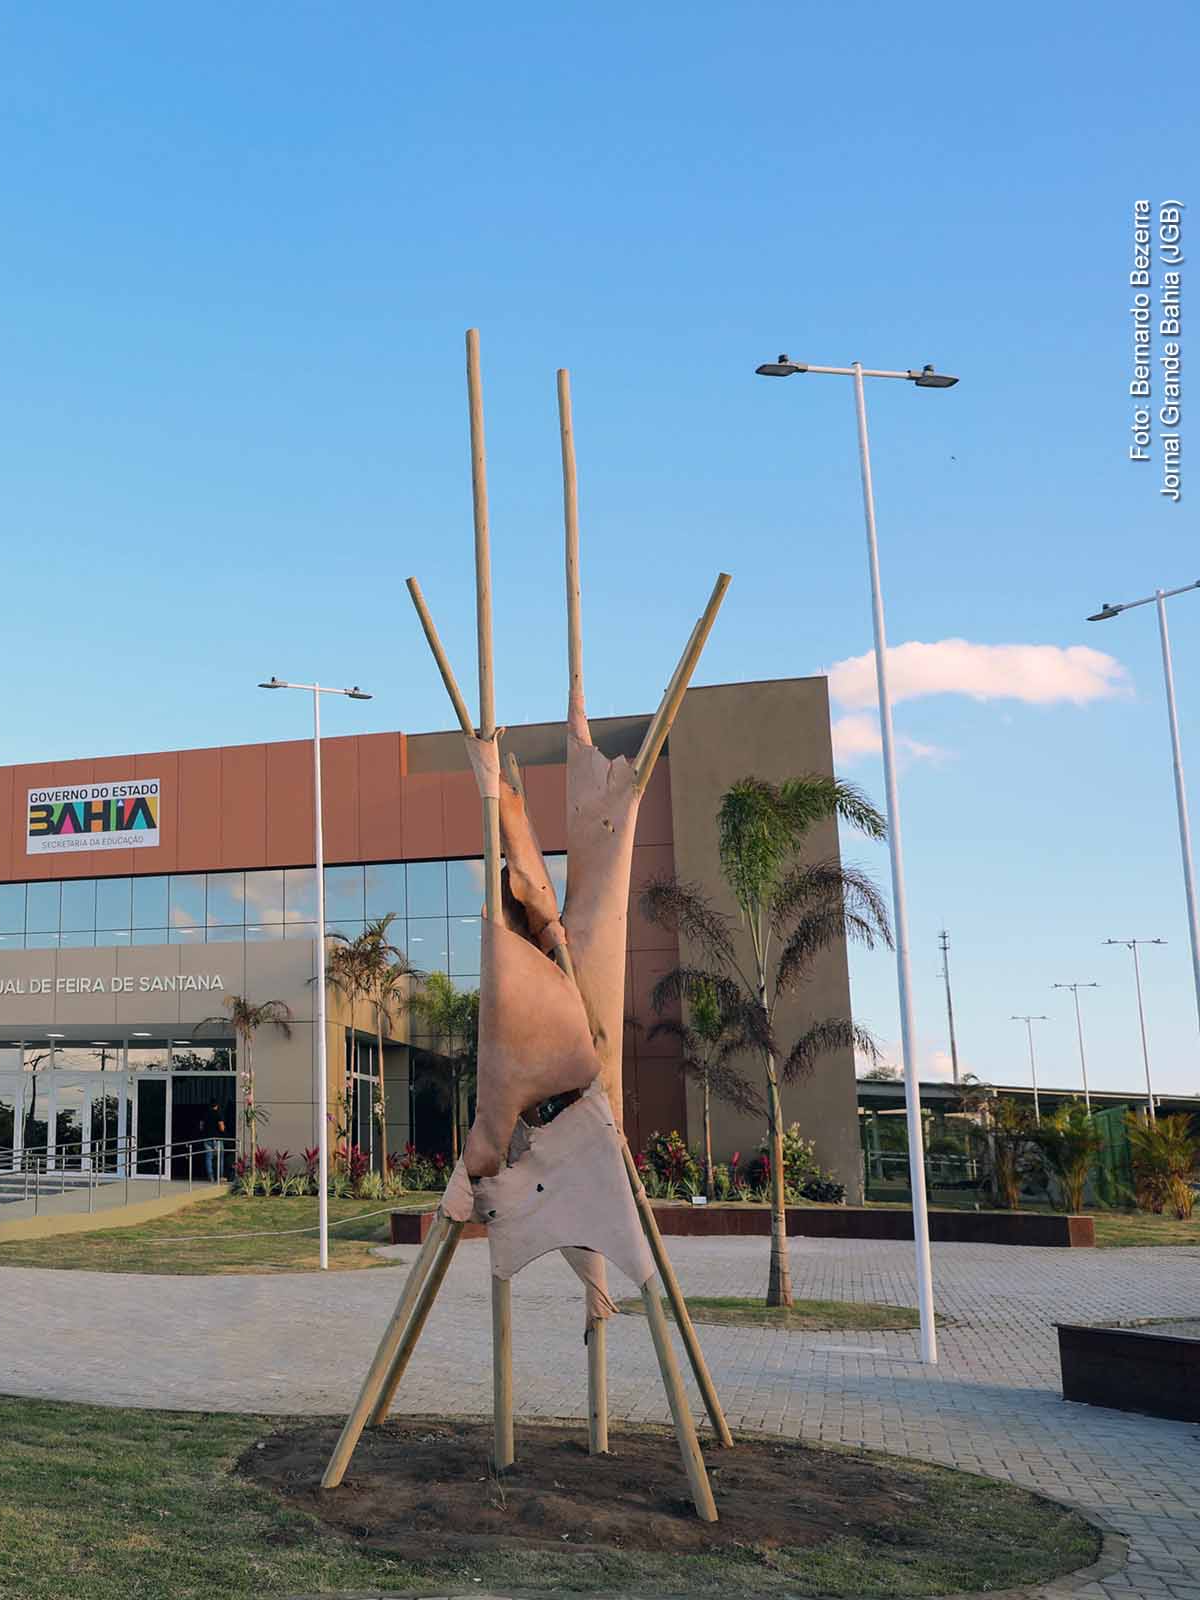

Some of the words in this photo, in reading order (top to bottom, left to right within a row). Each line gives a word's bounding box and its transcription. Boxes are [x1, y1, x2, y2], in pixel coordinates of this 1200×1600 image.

[30, 789, 88, 804] GOVERNO
[91, 787, 109, 799] DO
[112, 783, 158, 797] ESTADO
[42, 838, 88, 849] SECRETARIA
[89, 836, 100, 847] DA
[102, 834, 144, 846] EDUCAÇÃO
[29, 979, 51, 993] DE
[56, 977, 105, 993] FEIRA
[111, 977, 133, 992] DE
[139, 975, 224, 992] SANTANA
